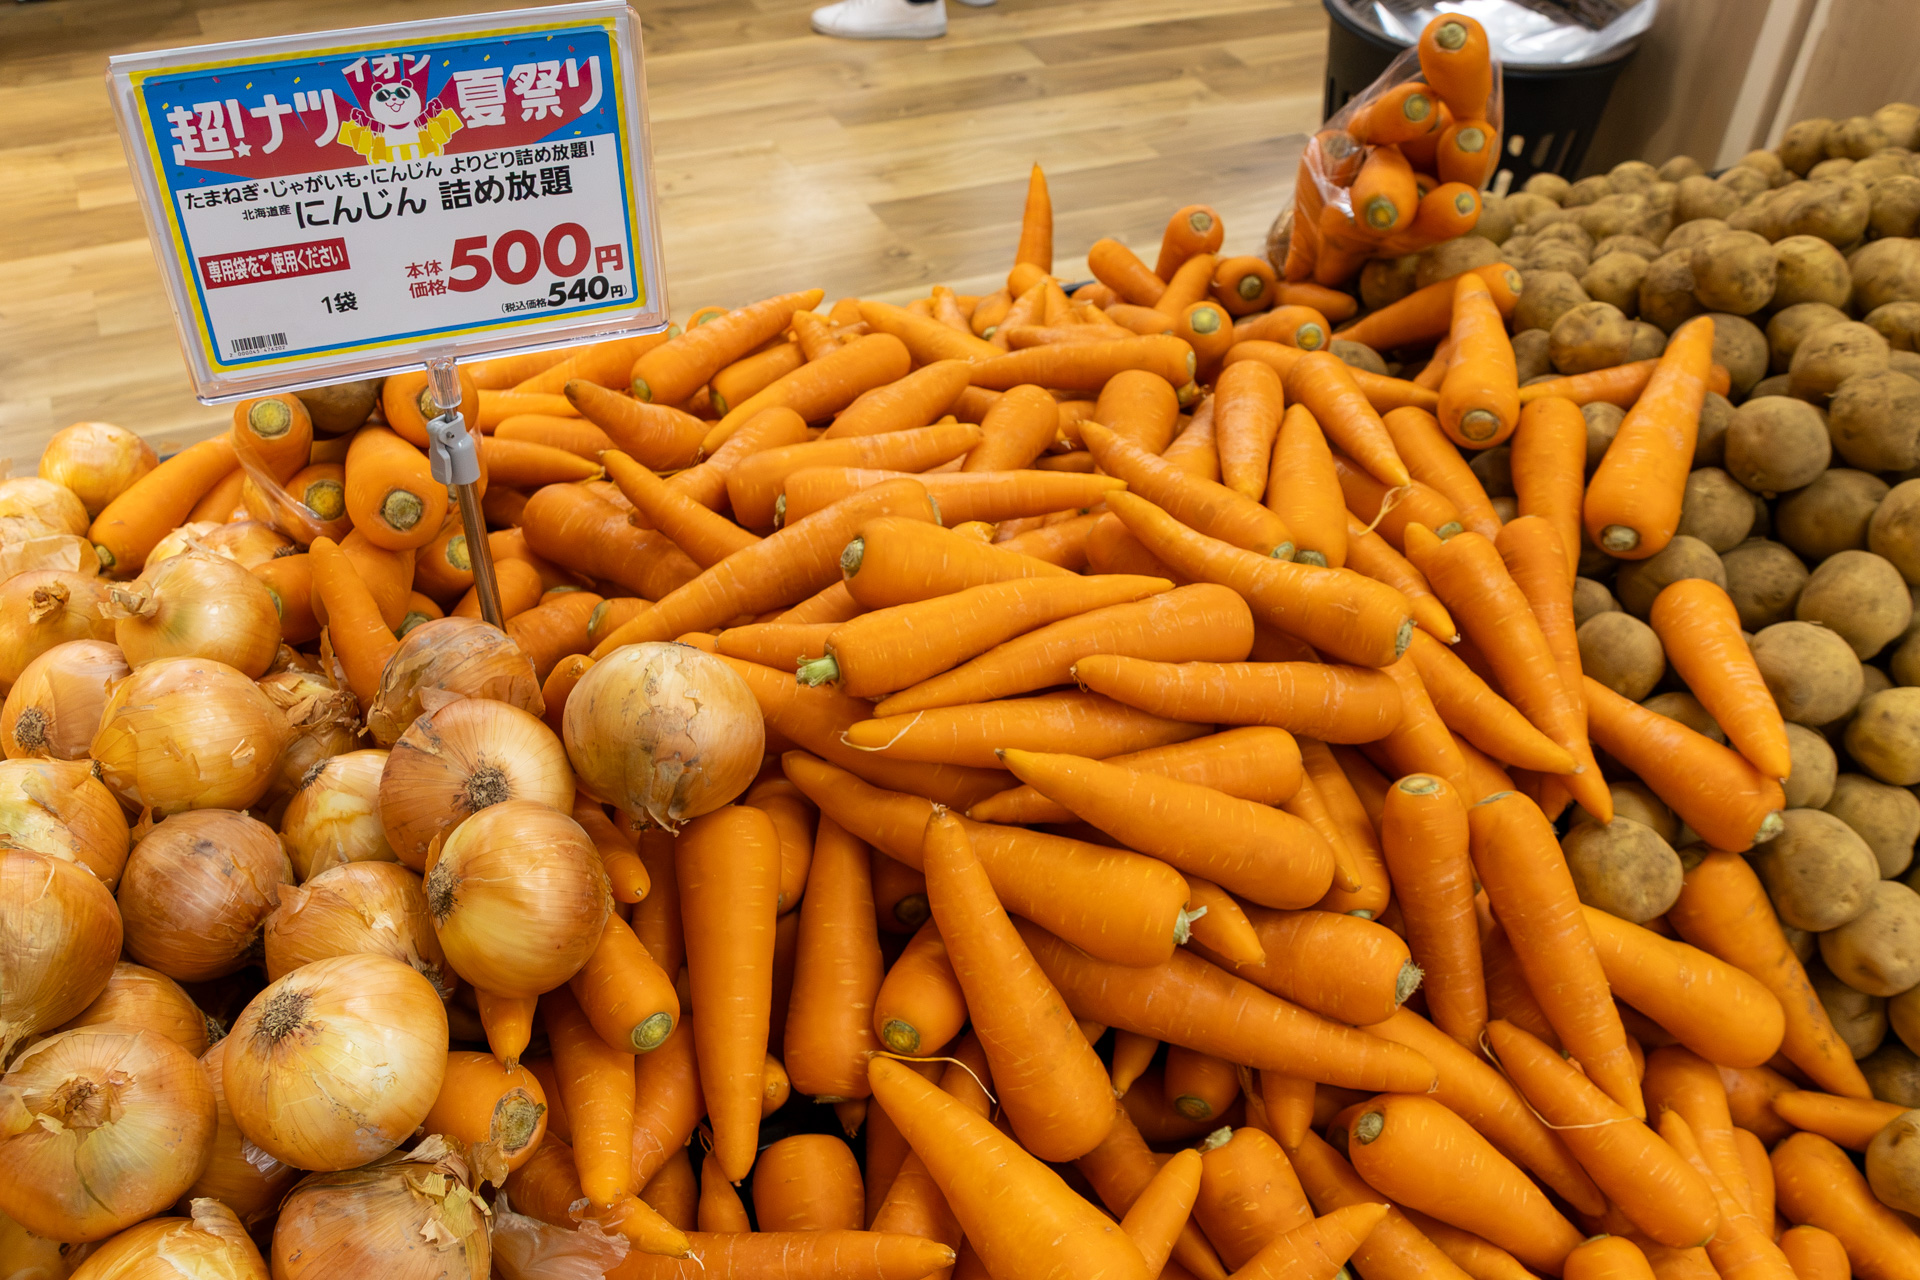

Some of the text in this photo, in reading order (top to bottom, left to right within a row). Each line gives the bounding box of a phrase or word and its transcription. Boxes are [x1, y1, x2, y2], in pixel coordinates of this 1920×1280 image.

[341, 53, 431, 82] イオン
[452, 55, 603, 129] 夏祭り
[242, 165, 573, 229] 北海道産 にんじん 詰め放題
[206, 245, 344, 283] 専用袋をご使用ください
[405, 259, 443, 280] 本体
[321, 291, 359, 314] 1袋
[409, 278, 448, 299] 価格
